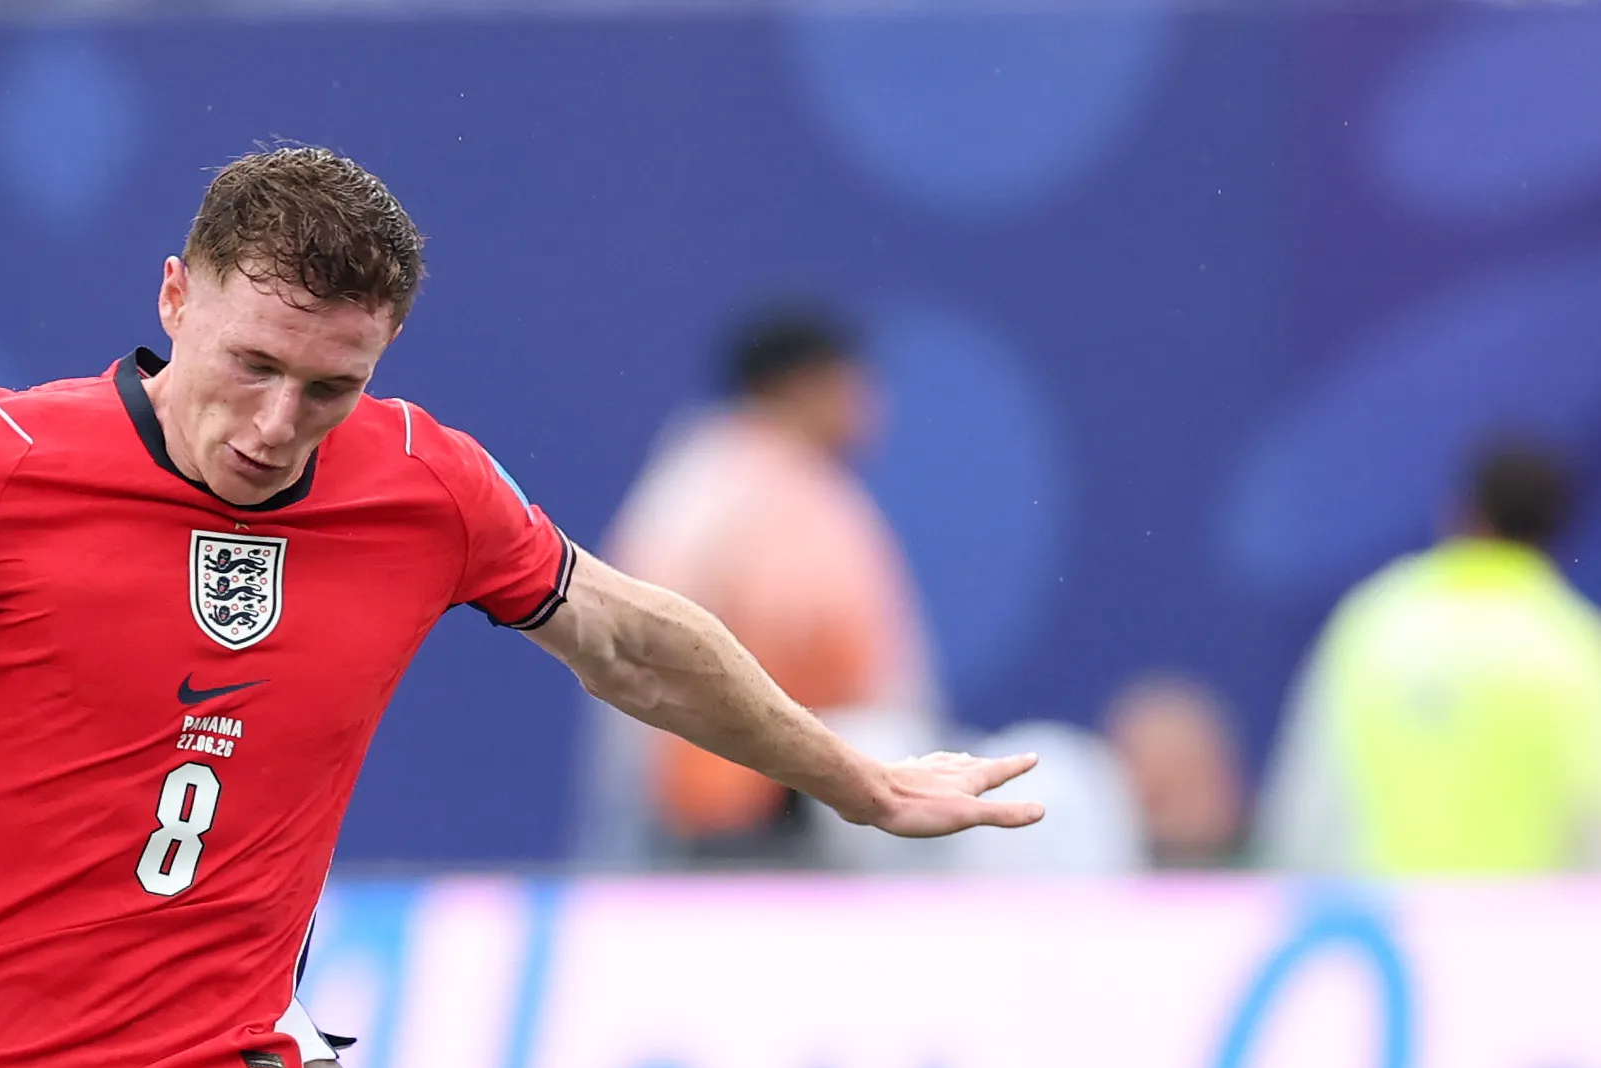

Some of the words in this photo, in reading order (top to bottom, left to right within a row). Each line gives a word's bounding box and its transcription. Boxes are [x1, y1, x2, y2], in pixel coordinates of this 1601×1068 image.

[182, 715, 243, 738] PANAMA
[176, 733, 234, 758] 27.06.26
[134, 761, 222, 897] 8
